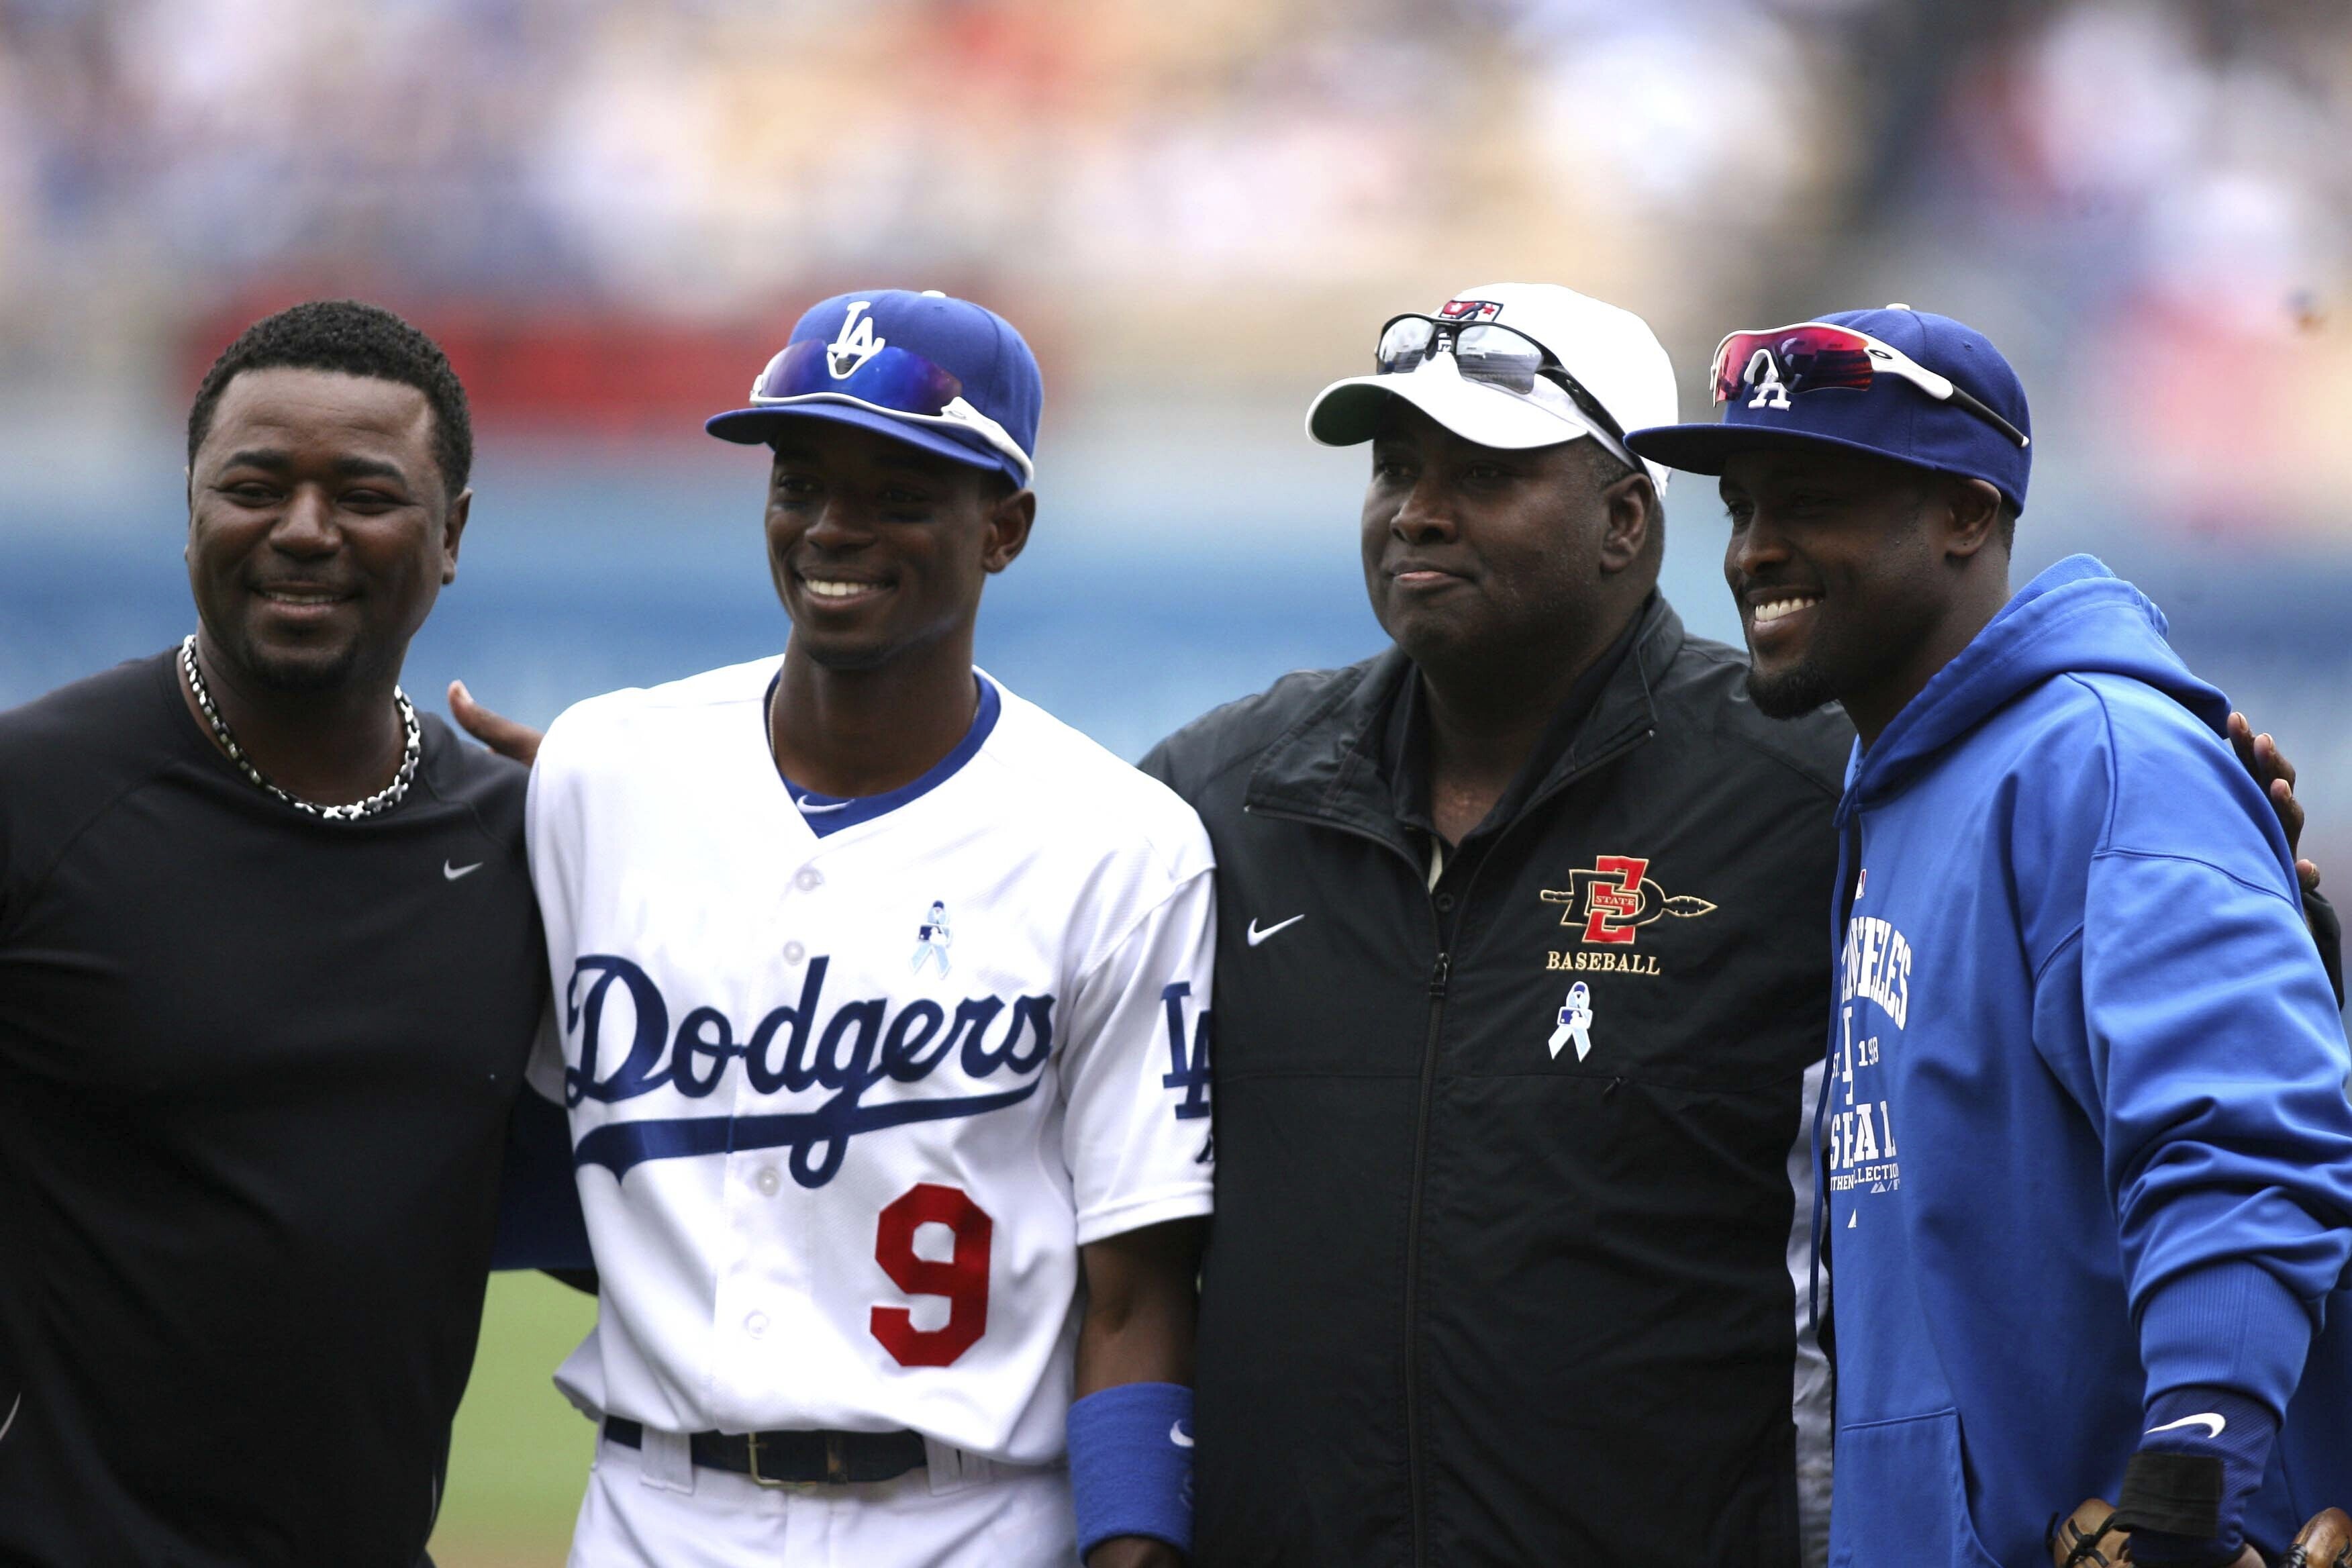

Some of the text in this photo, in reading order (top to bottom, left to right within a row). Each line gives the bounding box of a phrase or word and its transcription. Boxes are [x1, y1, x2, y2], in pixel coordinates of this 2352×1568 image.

[1595, 895, 1636, 906] STATE
[1546, 950, 1661, 975] BASEBALL
[566, 954, 1055, 1188] Dodgers
[871, 1183, 993, 1367] 9
